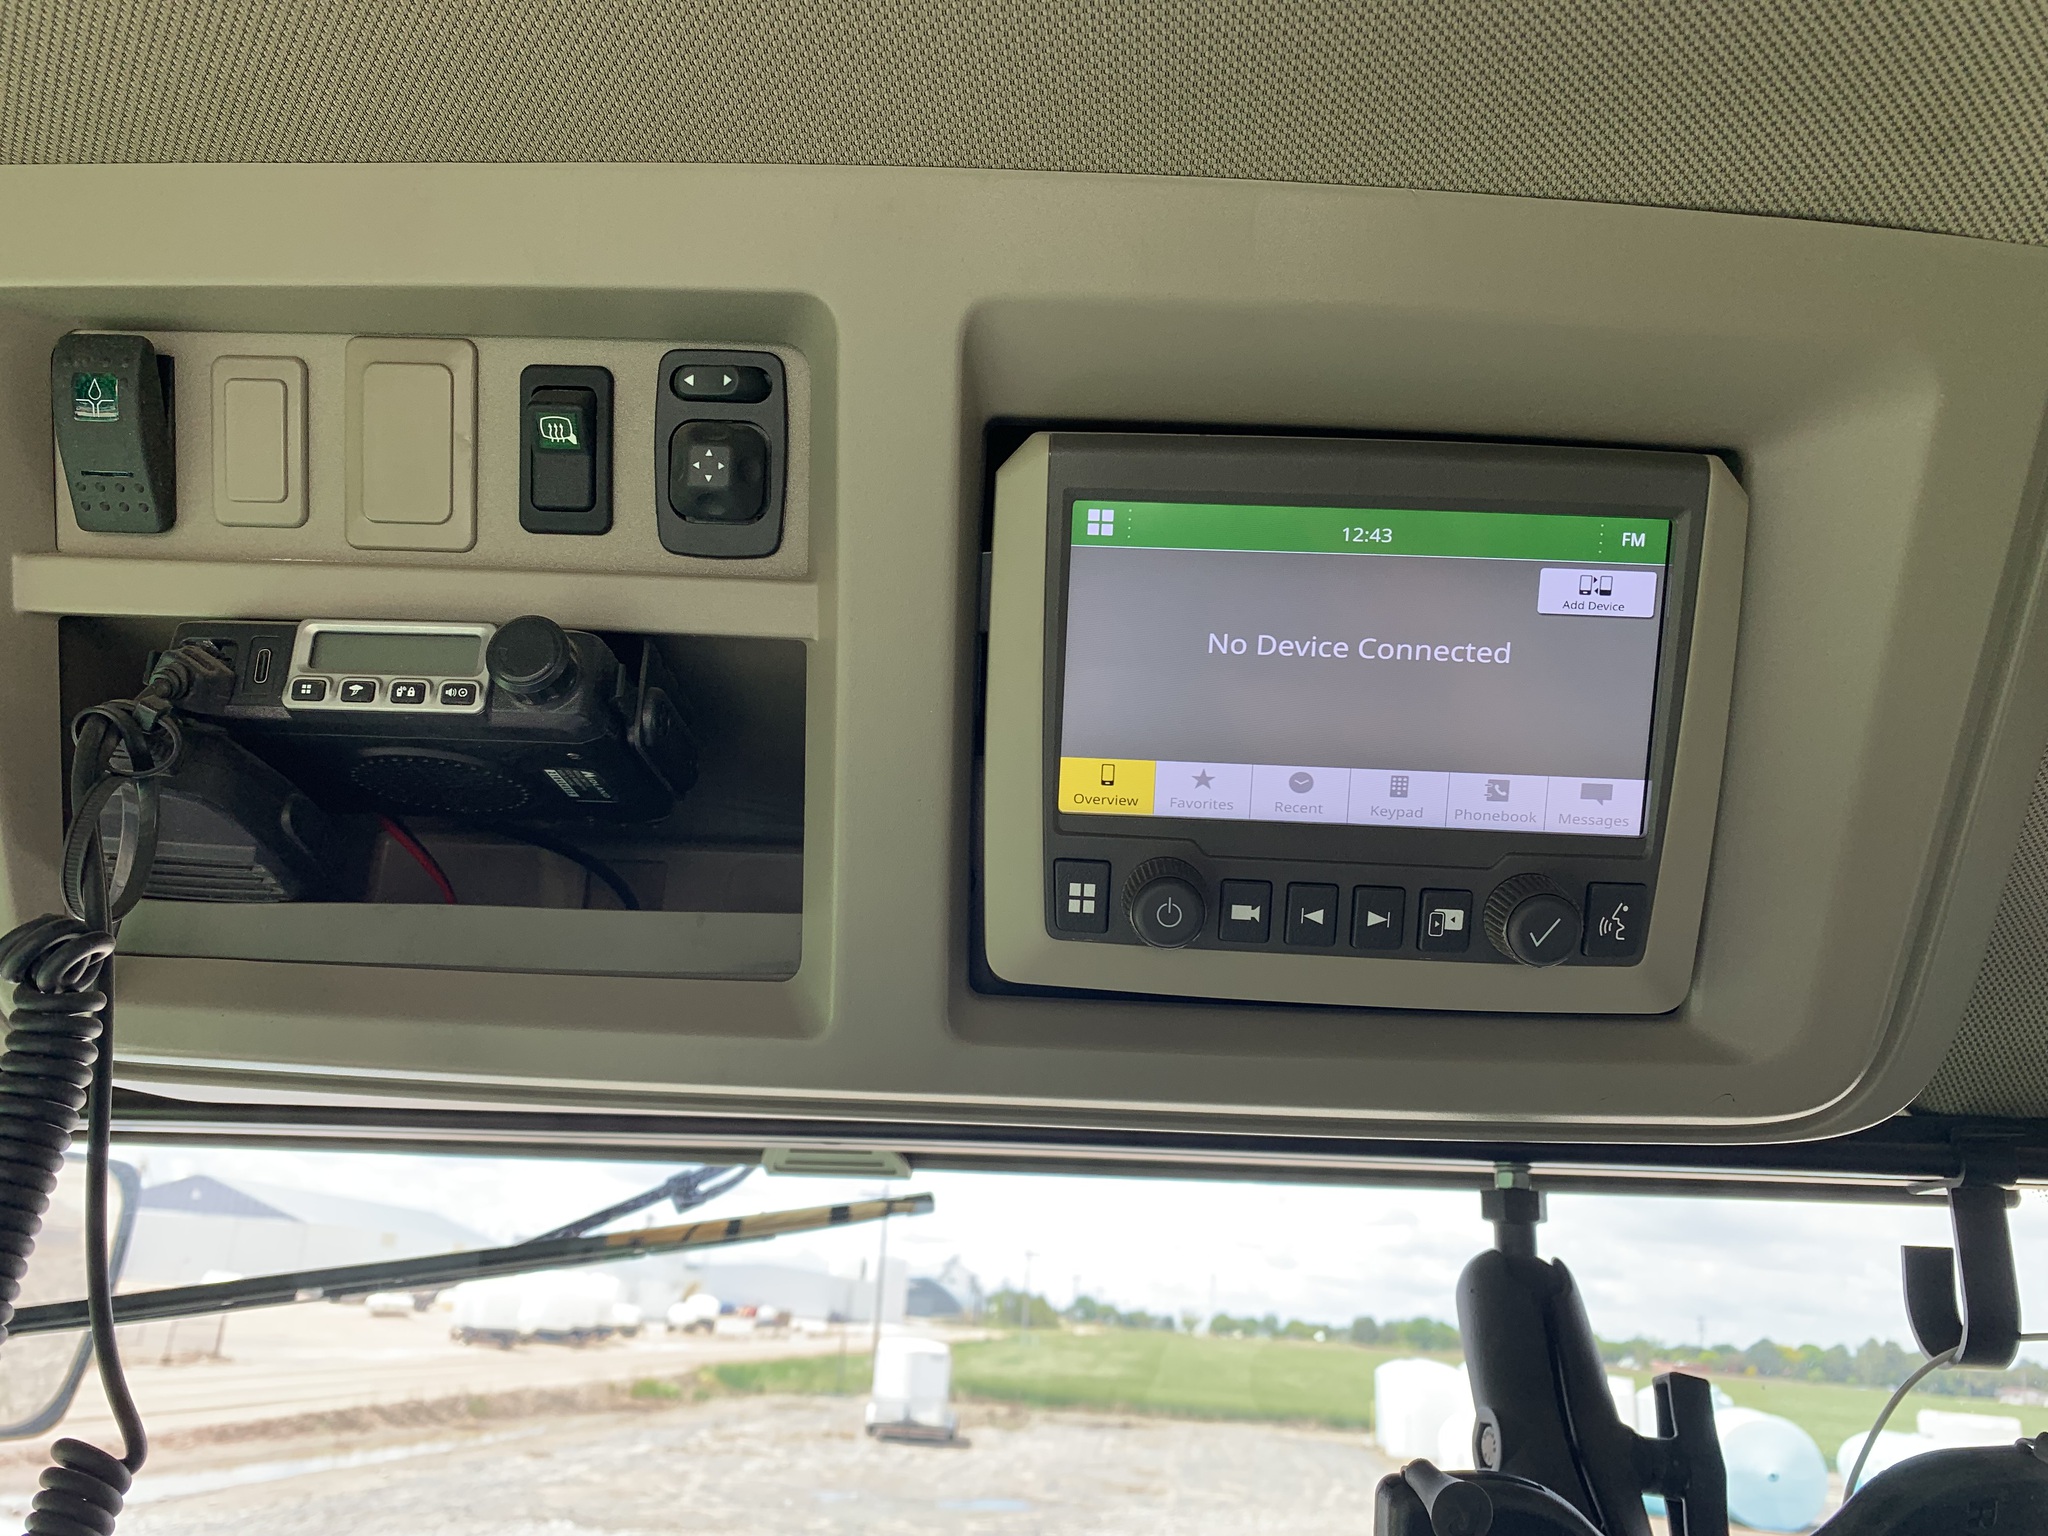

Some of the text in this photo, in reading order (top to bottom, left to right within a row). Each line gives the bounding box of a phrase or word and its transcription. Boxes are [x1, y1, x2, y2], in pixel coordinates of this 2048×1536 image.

[1342, 527, 1393, 543] 12:43
[1621, 532, 1646, 548] FM
[1562, 600, 1625, 612] Add Device
[1207, 632, 1512, 664] No Device Connected
[1073, 793, 1139, 807] Overview
[1169, 797, 1234, 811] Favorites
[1274, 801, 1324, 815] Recent
[1370, 804, 1424, 820] Keypad
[1454, 808, 1537, 824] Phonebook
[1558, 813, 1630, 829] Messages
